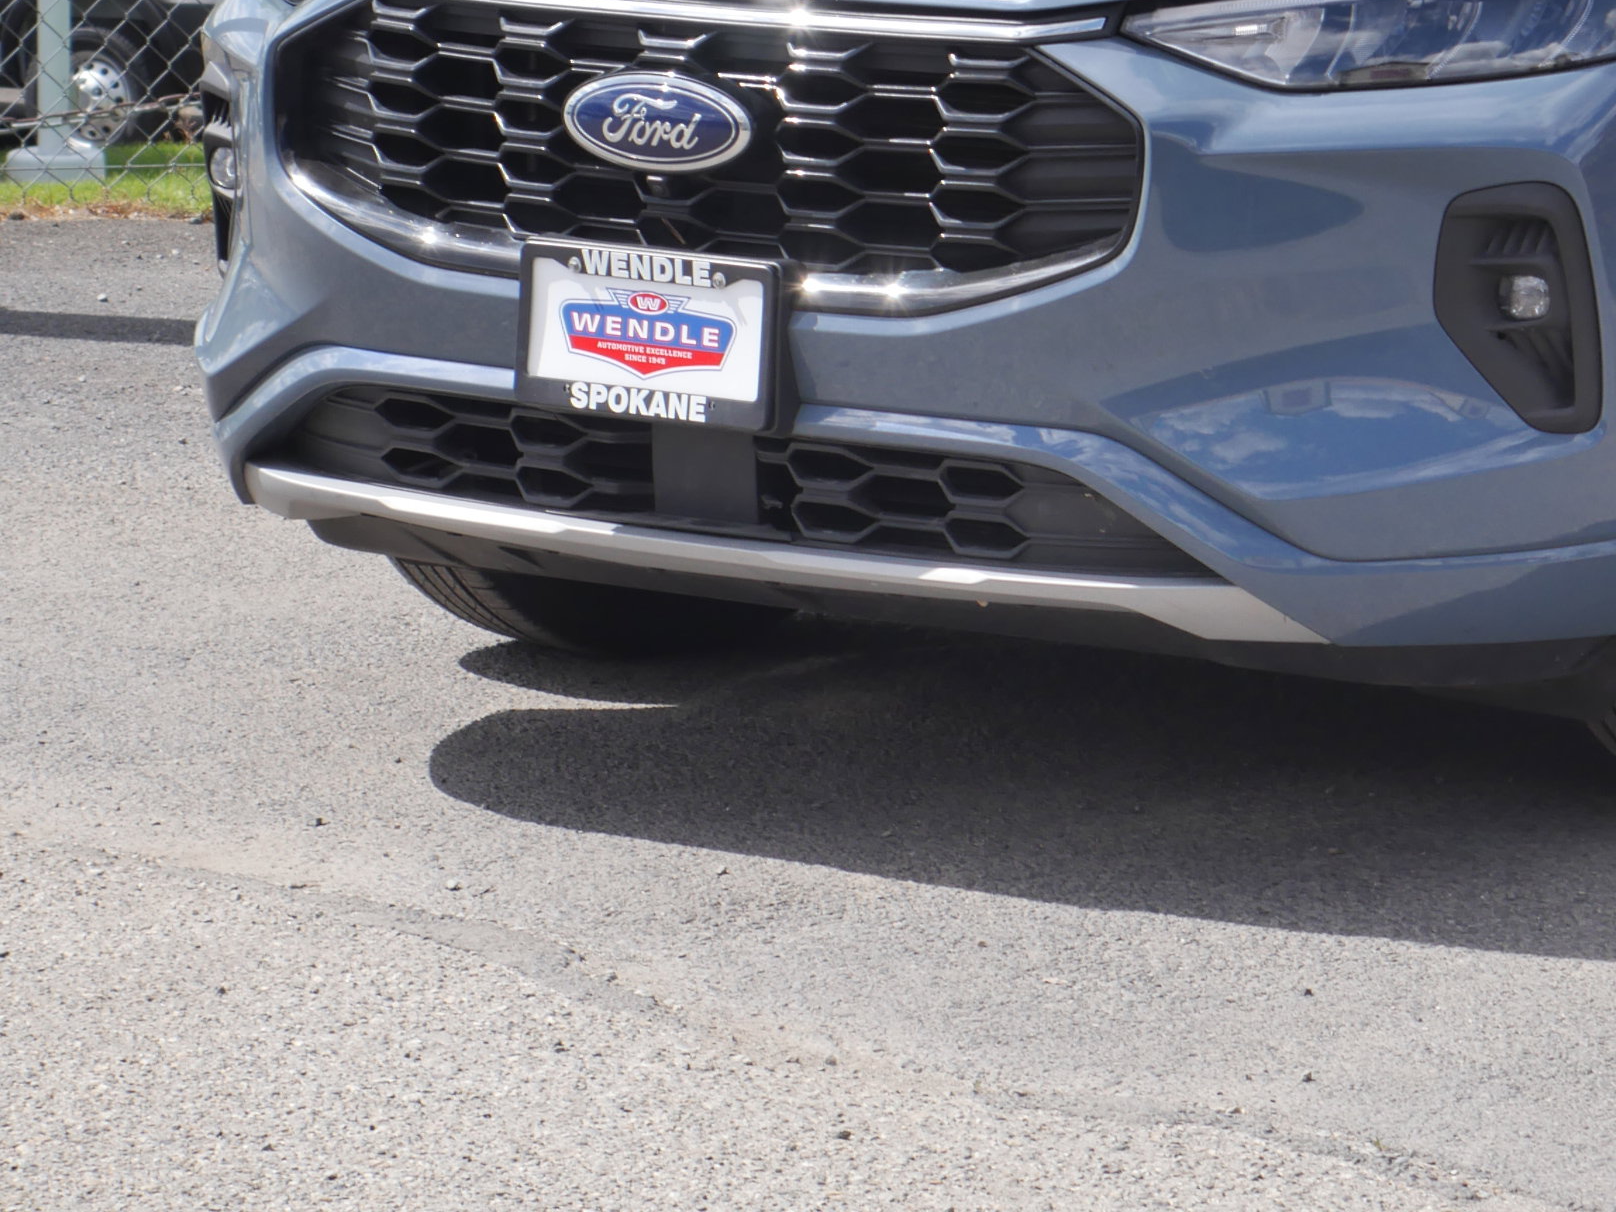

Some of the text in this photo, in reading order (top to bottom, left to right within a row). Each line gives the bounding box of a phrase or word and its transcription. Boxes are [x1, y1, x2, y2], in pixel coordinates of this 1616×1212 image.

[602, 93, 702, 150] Ford
[581, 248, 712, 288] WENDLE
[570, 311, 720, 348] WENDLE
[596, 341, 694, 360] AUTOMOTIVE EXCELLENCE
[624, 354, 647, 363] SINCE
[569, 381, 707, 423] SPOKANE
